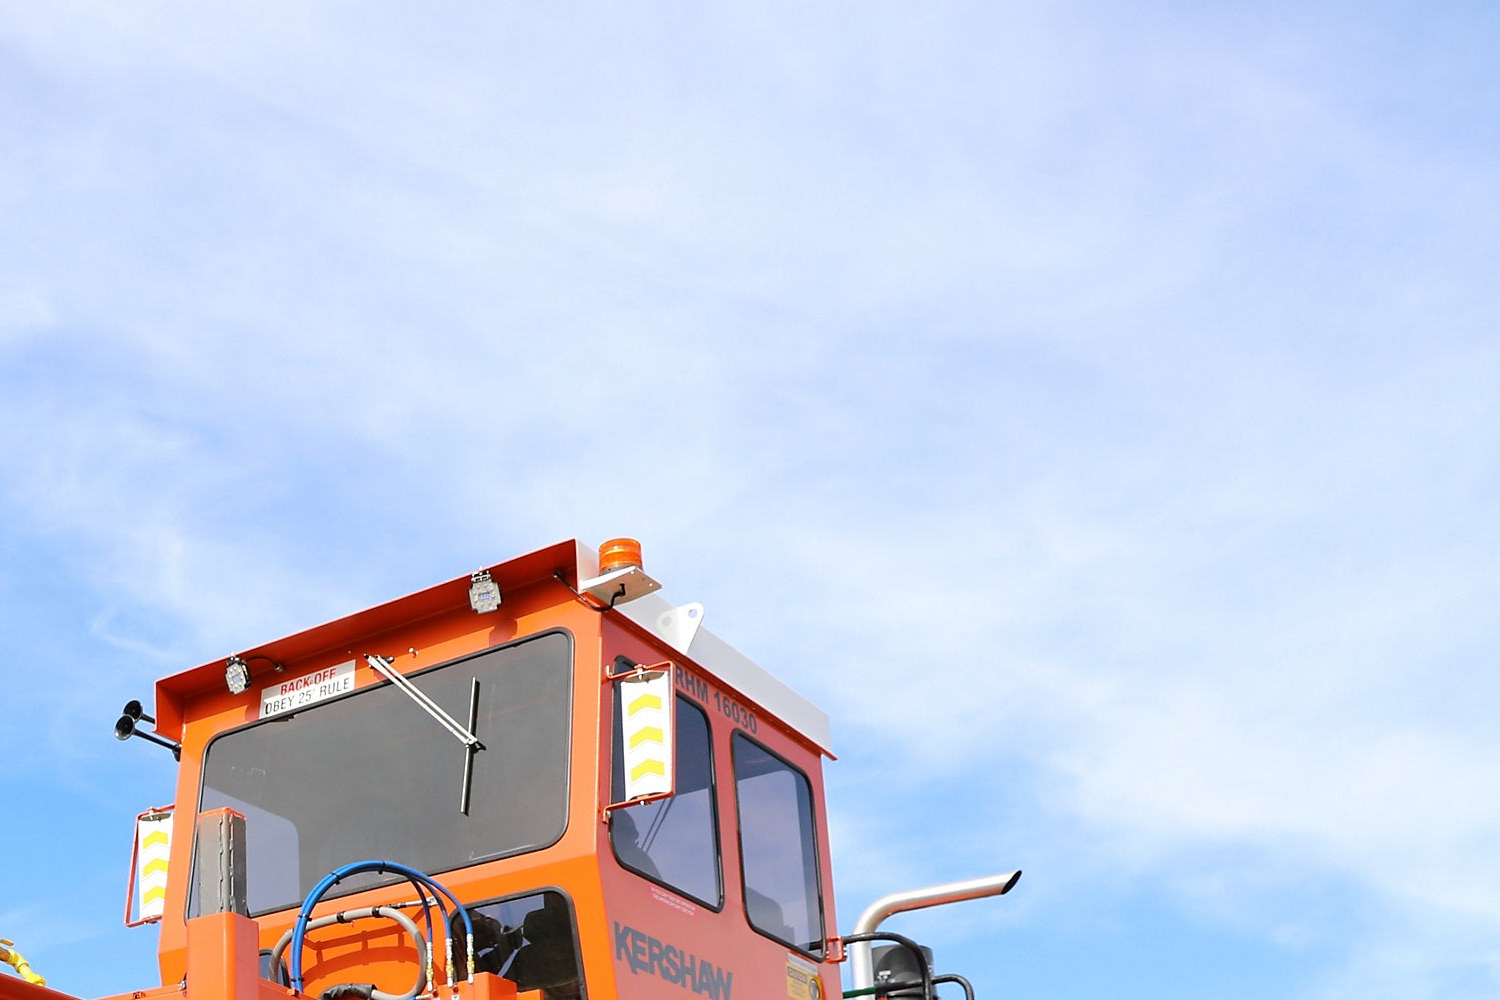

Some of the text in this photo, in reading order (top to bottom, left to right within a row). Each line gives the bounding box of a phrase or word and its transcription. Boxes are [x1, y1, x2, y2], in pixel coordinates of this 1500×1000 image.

[265, 695, 295, 715] OBEY
[319, 677, 350, 698] RULE
[280, 667, 337, 696] BACK OFF
[675, 664, 757, 734] RHM 16030
